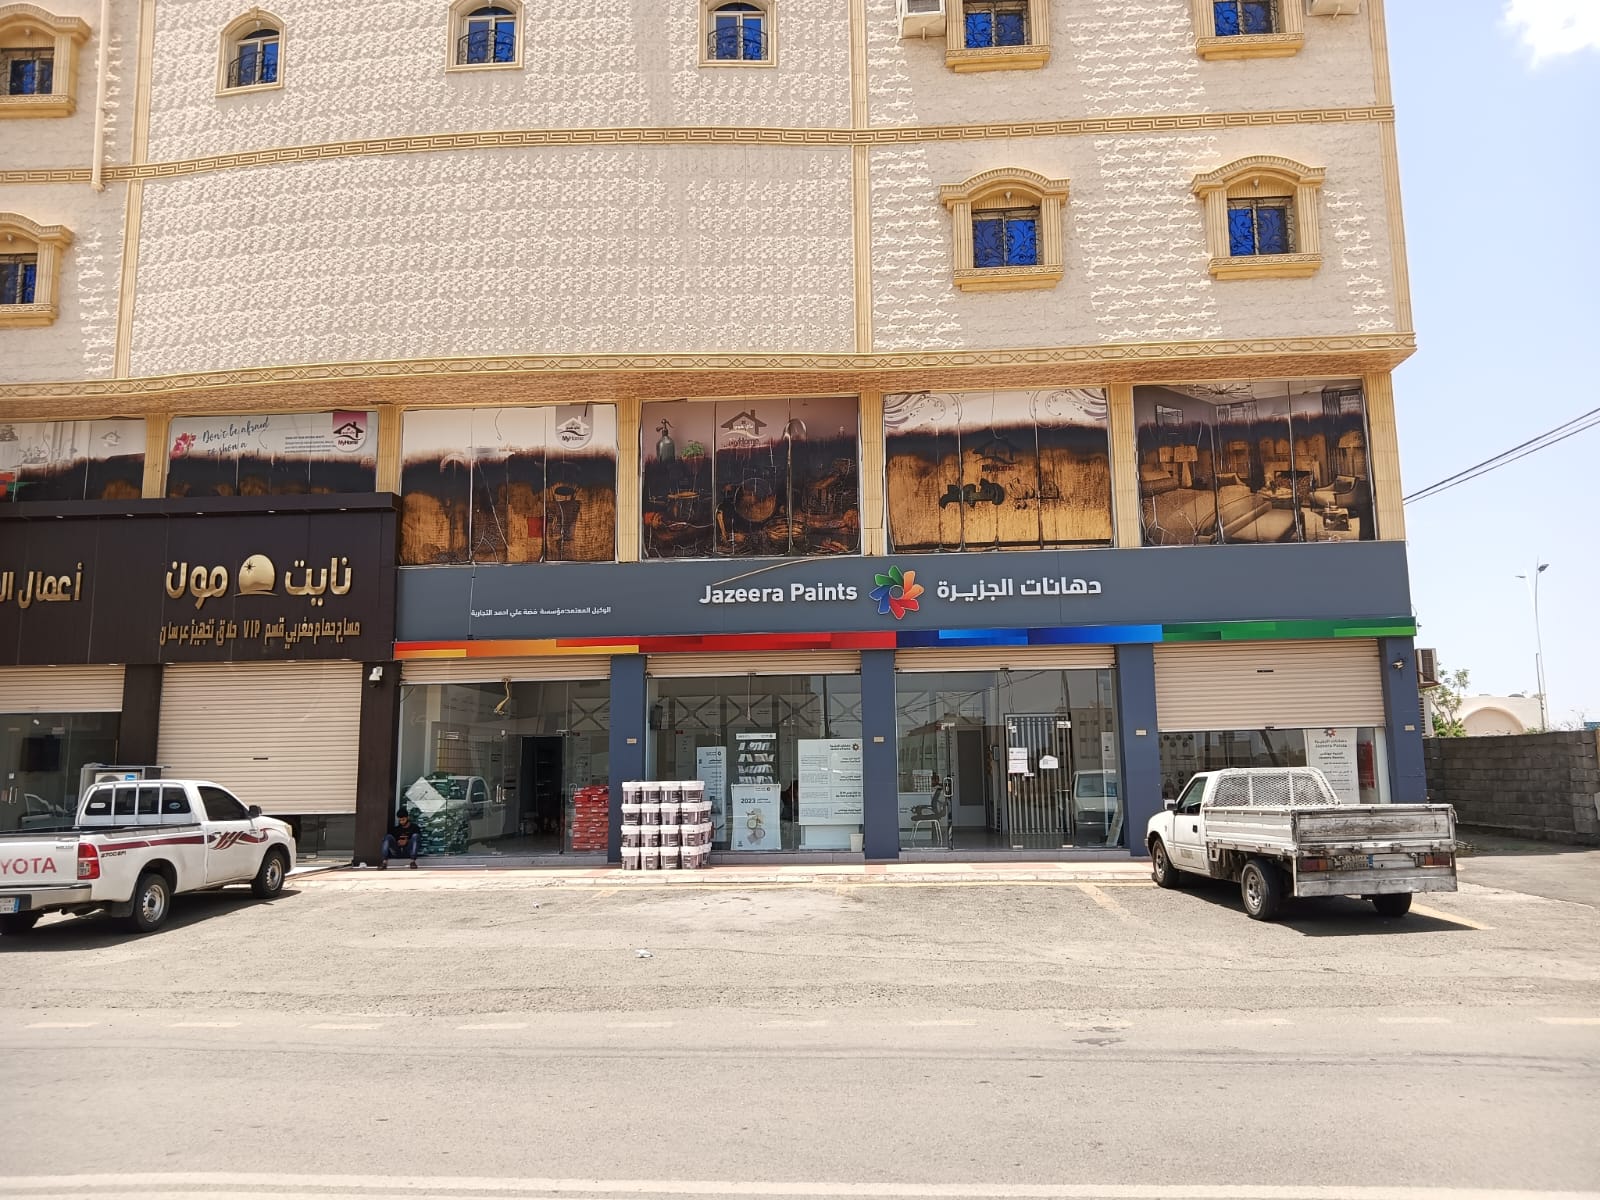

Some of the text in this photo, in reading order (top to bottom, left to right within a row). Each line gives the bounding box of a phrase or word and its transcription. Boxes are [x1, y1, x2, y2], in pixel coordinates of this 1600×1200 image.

[230, 423, 239, 437] be
[18, 561, 82, 609] أعمال
[165, 556, 353, 610] نايت مون
[698, 582, 858, 604] Jazeera Paints
[936, 576, 1102, 602] دهانات الجزيرة
[243, 619, 261, 639] VIP
